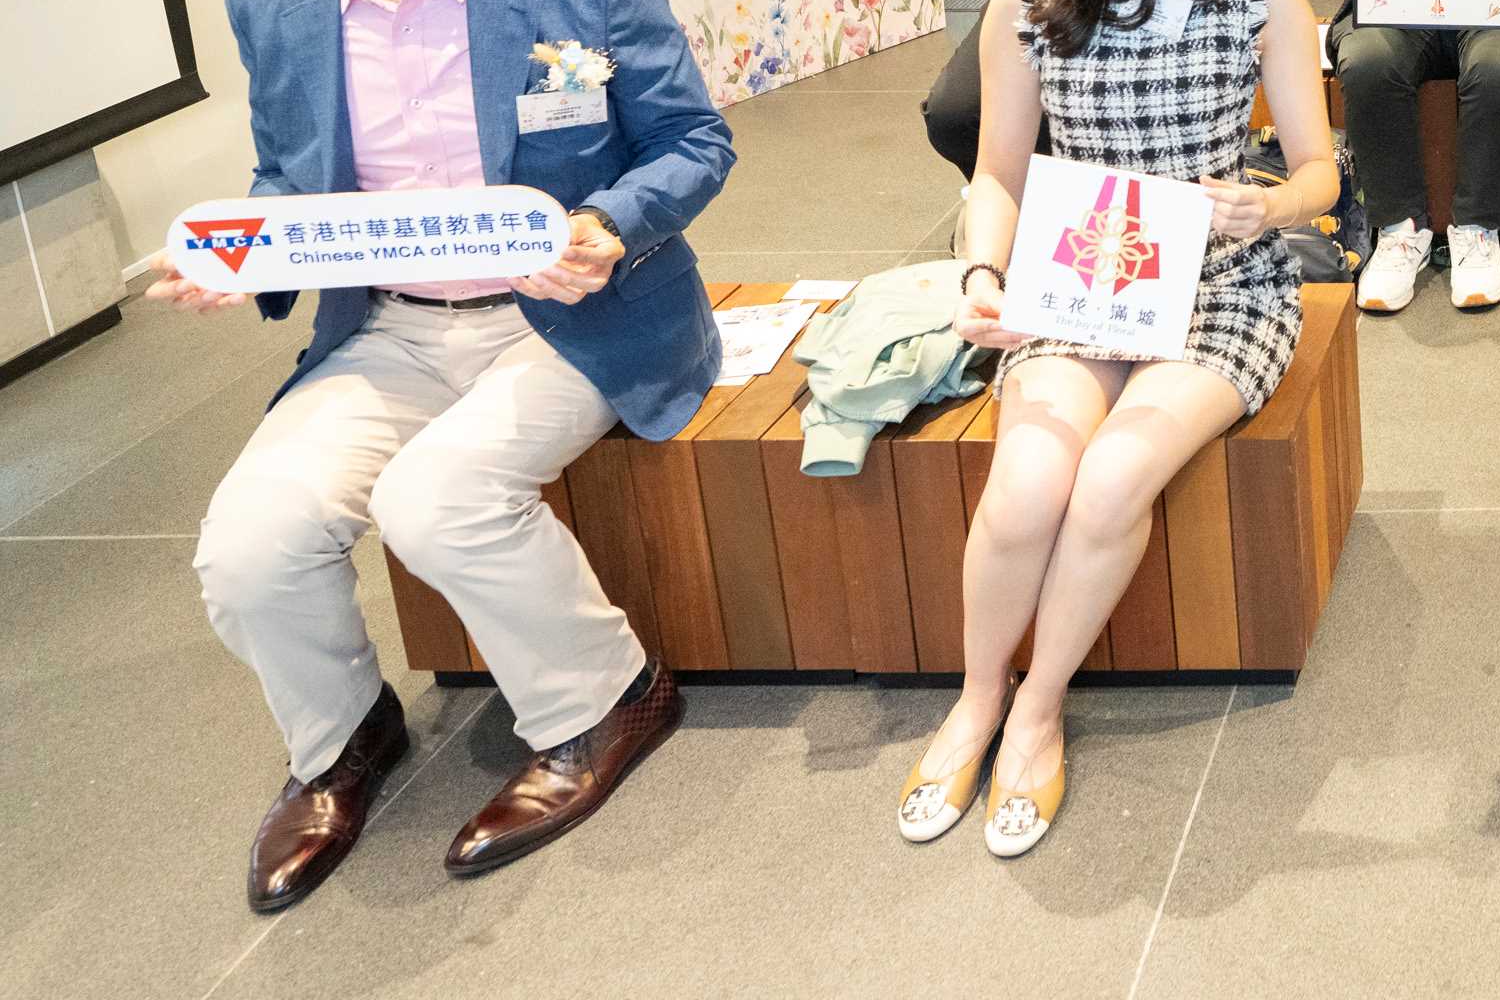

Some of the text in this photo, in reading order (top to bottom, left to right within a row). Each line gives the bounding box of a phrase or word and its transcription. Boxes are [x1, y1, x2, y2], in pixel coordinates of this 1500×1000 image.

[283, 209, 549, 245] 香港中華基督教青年會
[190, 234, 270, 250] YMCA
[289, 237, 554, 266] Chinese YMCA of Hong Kong
